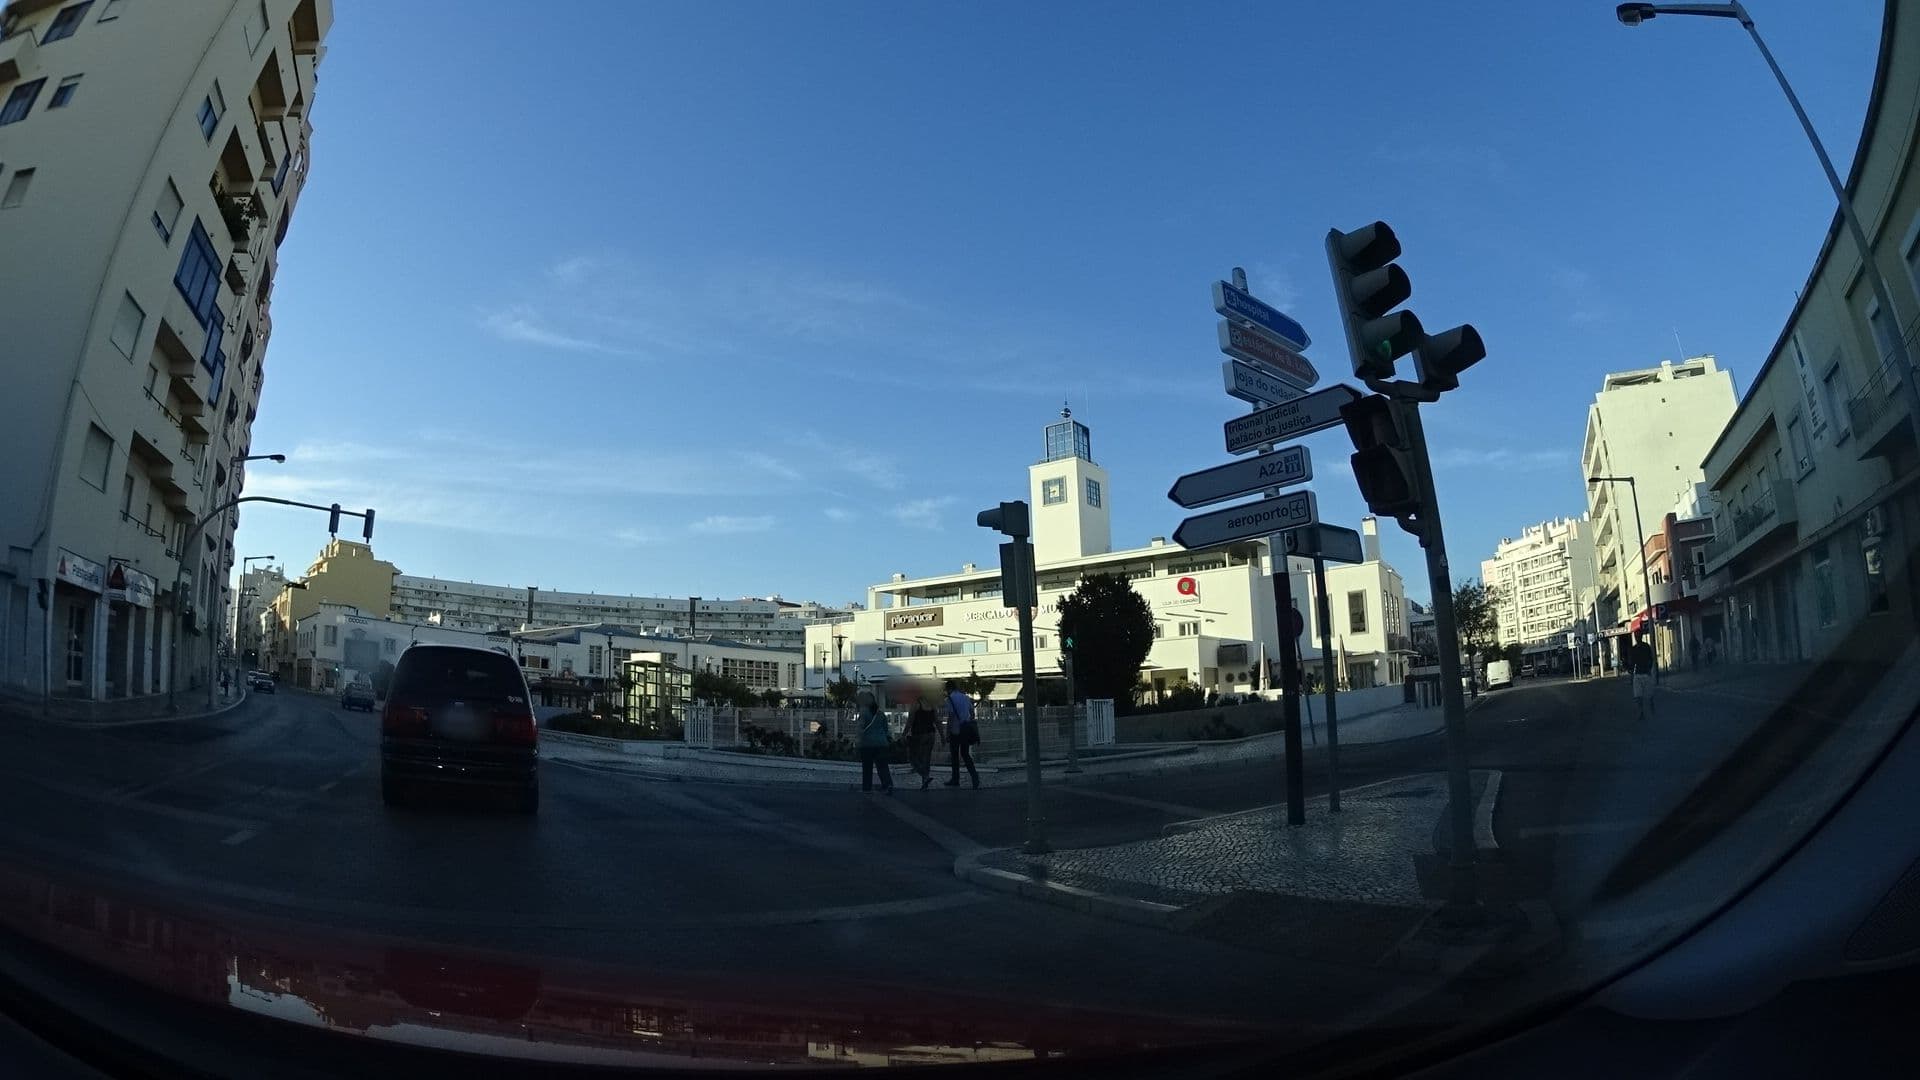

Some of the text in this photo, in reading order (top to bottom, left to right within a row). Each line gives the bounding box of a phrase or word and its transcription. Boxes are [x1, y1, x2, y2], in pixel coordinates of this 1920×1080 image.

[1235, 367, 1254, 387] loja
[1256, 377, 1268, 391] do
[1228, 403, 1299, 434] tribunal judicial
[1230, 414, 1312, 448] palácio da justiça
[1259, 461, 1283, 478] A22
[1227, 507, 1289, 529] aeroporto
[966, 608, 1014, 621] MERCADO
